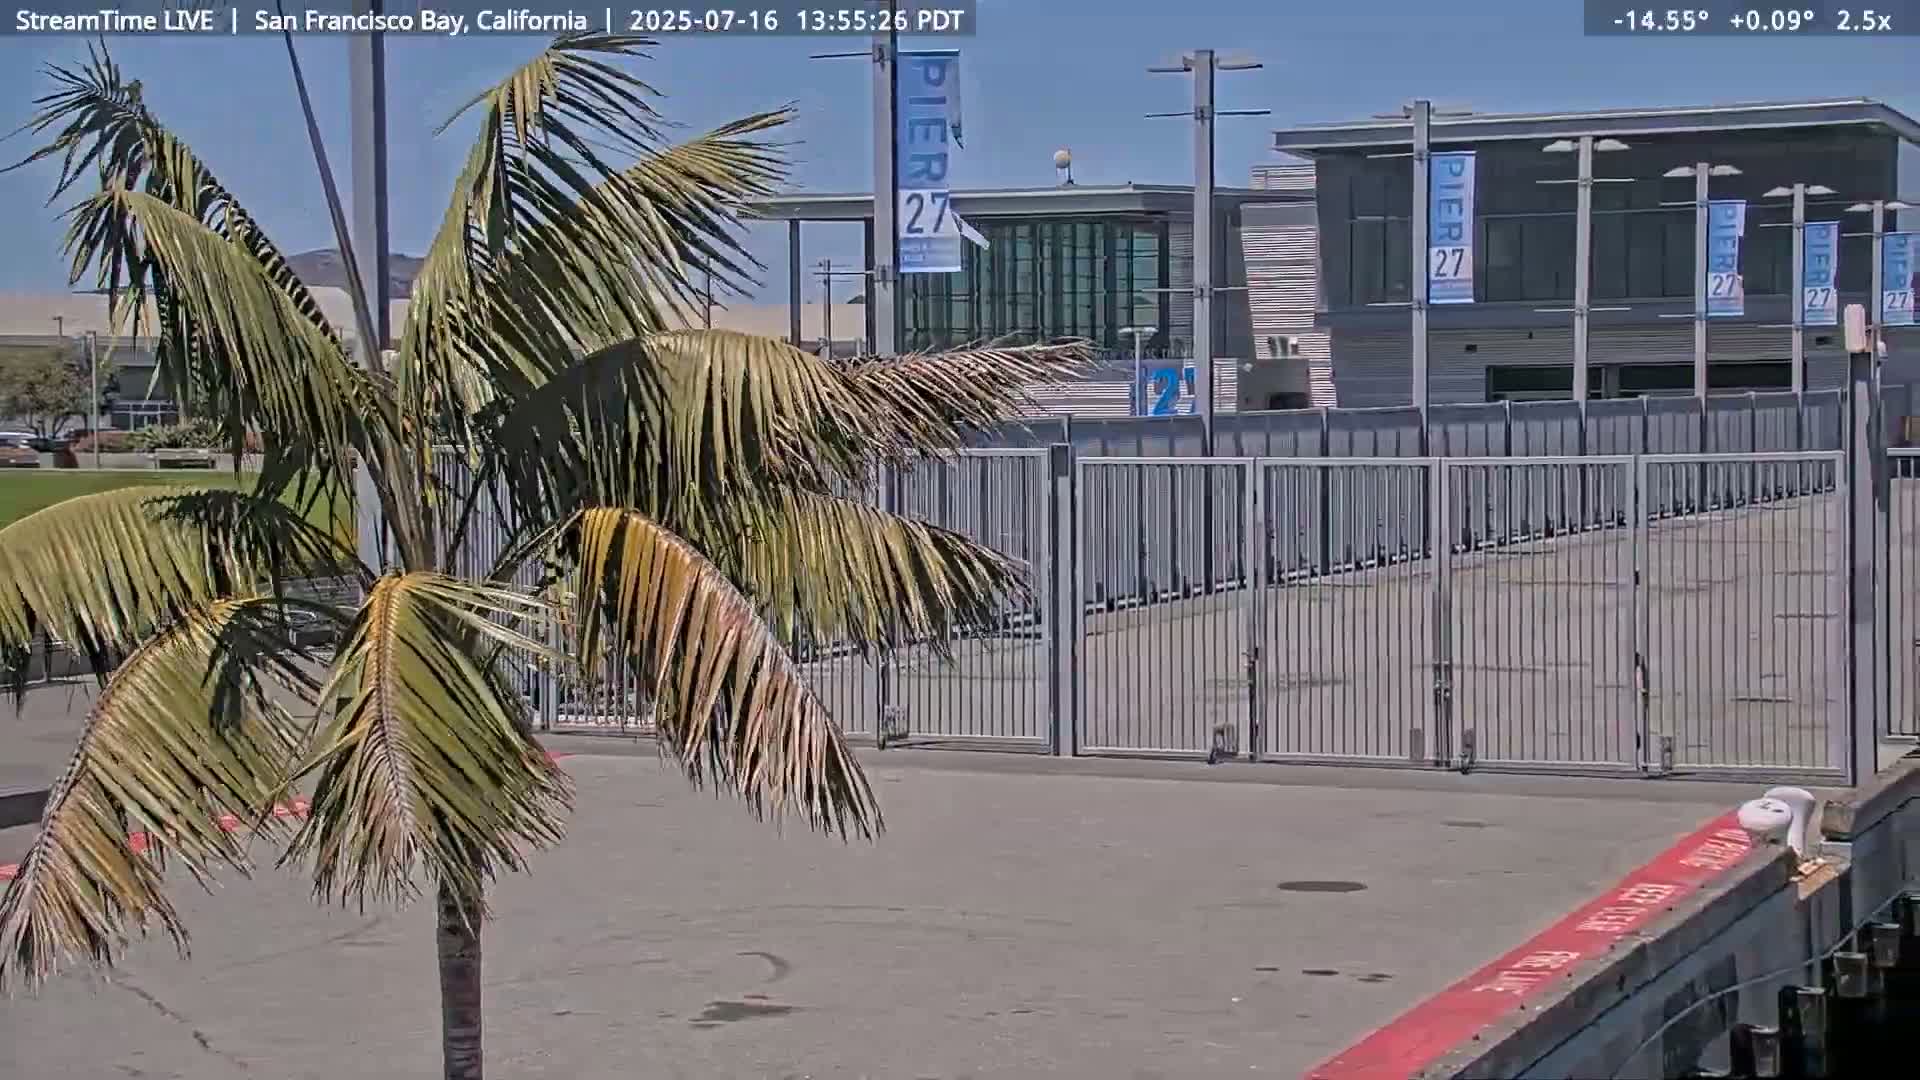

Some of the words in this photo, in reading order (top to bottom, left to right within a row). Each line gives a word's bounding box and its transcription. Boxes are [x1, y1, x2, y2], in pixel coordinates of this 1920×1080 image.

[908, 59, 948, 182] PIER
[905, 191, 950, 235] 27
[1438, 158, 1466, 241] PIER
[1434, 247, 1465, 278] 27
[1712, 273, 1737, 296] 27
[1807, 287, 1831, 308] 27
[1887, 291, 1909, 309] 27
